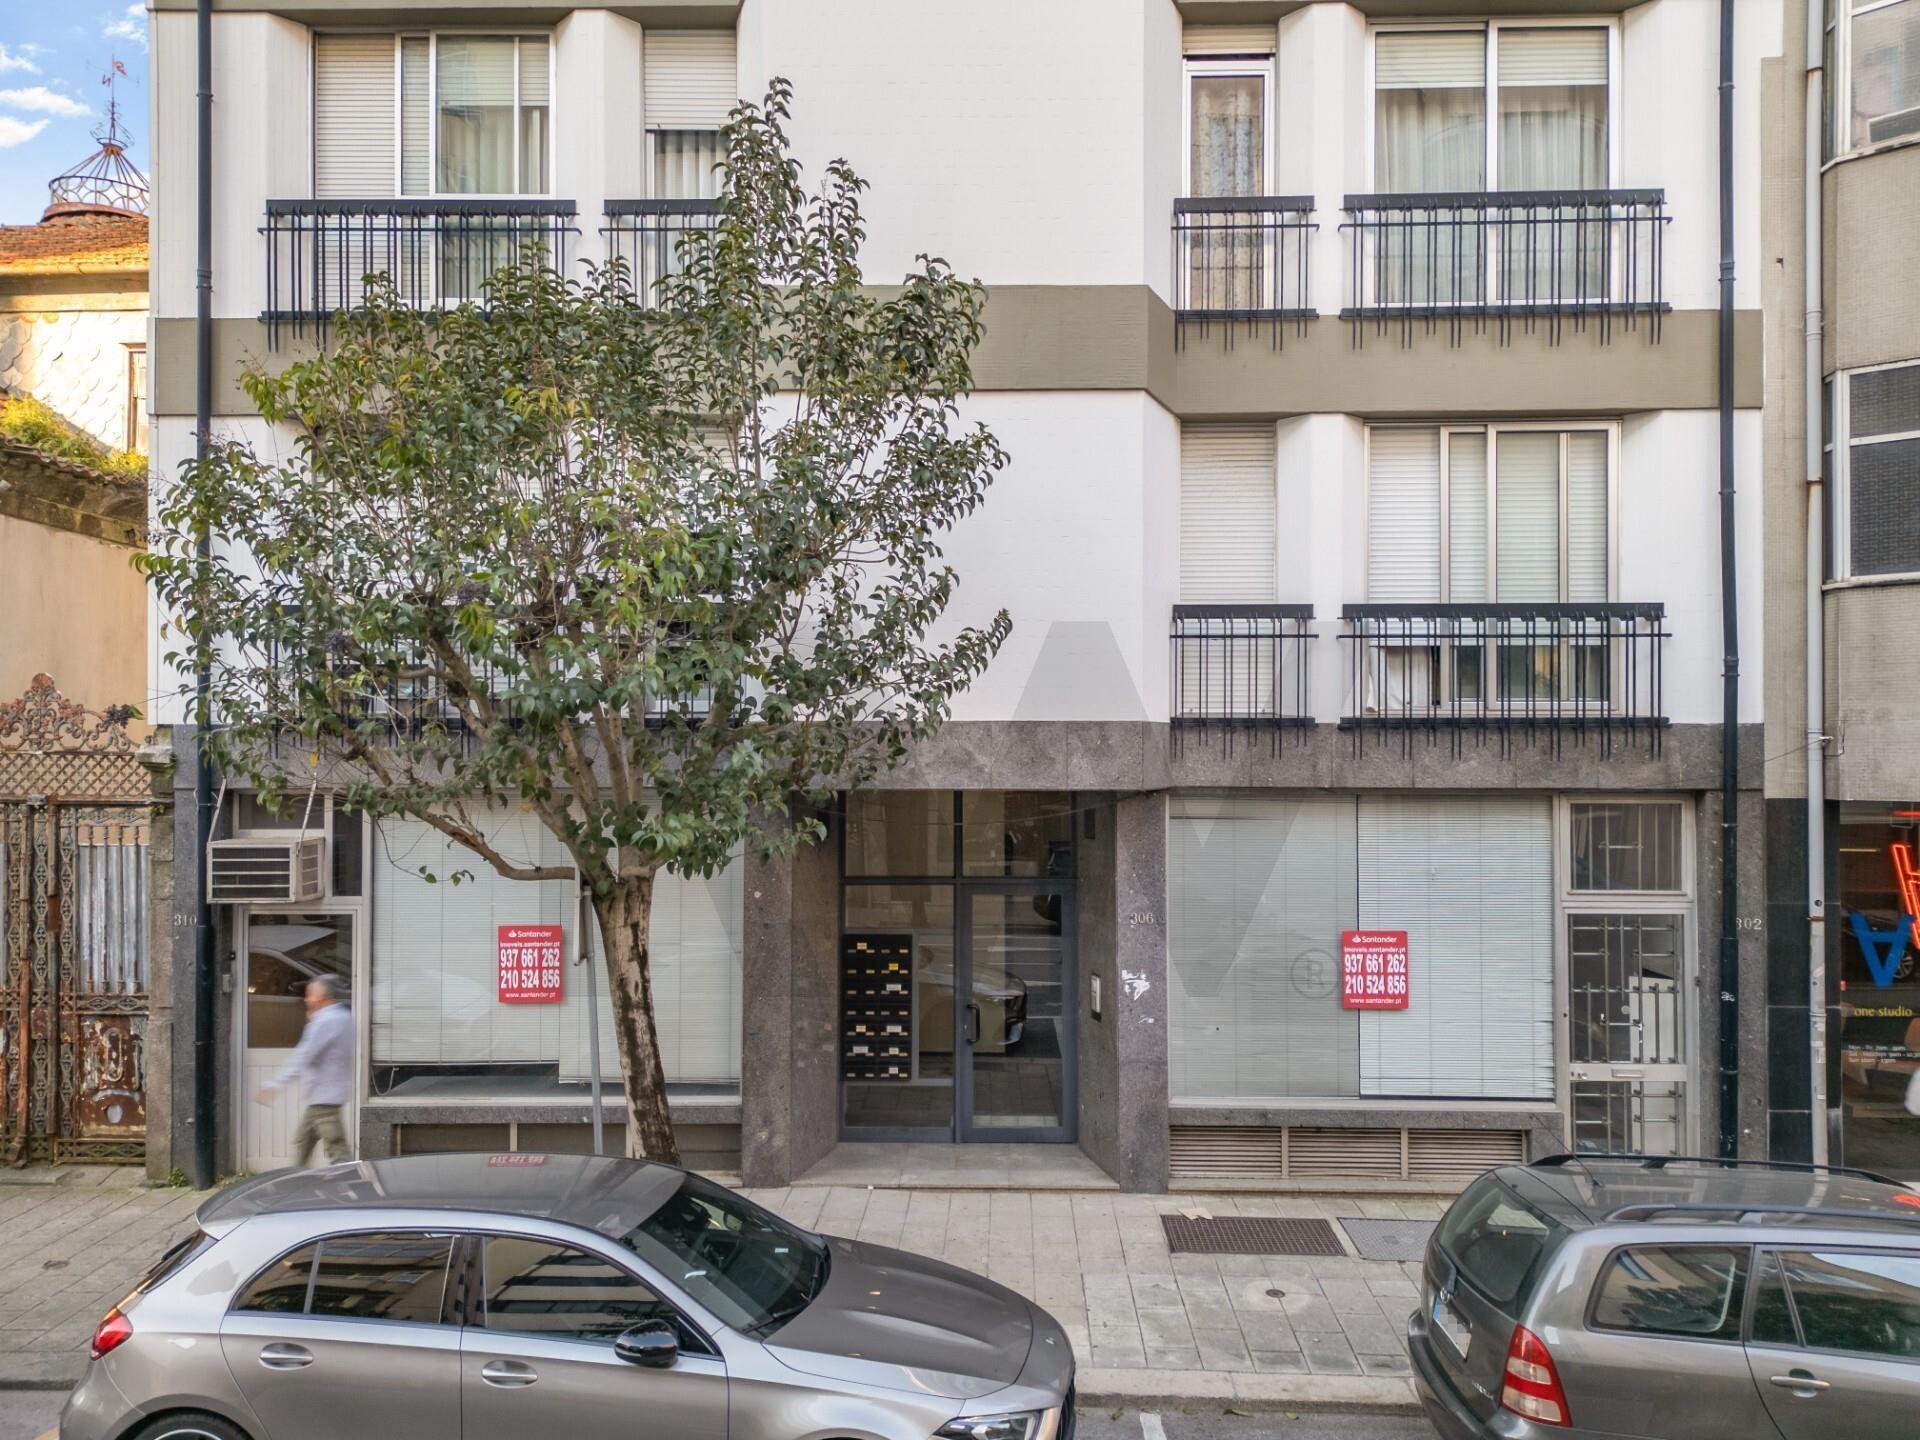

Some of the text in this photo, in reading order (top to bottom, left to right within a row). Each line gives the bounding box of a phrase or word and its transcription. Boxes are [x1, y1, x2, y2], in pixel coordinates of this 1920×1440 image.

[174, 914, 198, 927] 310
[1130, 911, 1154, 925] 306
[517, 930, 552, 938] Santander
[1361, 935, 1398, 943] Santander
[500, 948, 560, 968] 937 661 262
[1344, 953, 1406, 973] 937 661 262
[500, 969, 560, 989] 210 524 856
[1345, 974, 1406, 994] 210 524 856
[1350, 997, 1402, 1005] www.santander.pt
[1854, 1004, 1913, 1016] one studio
